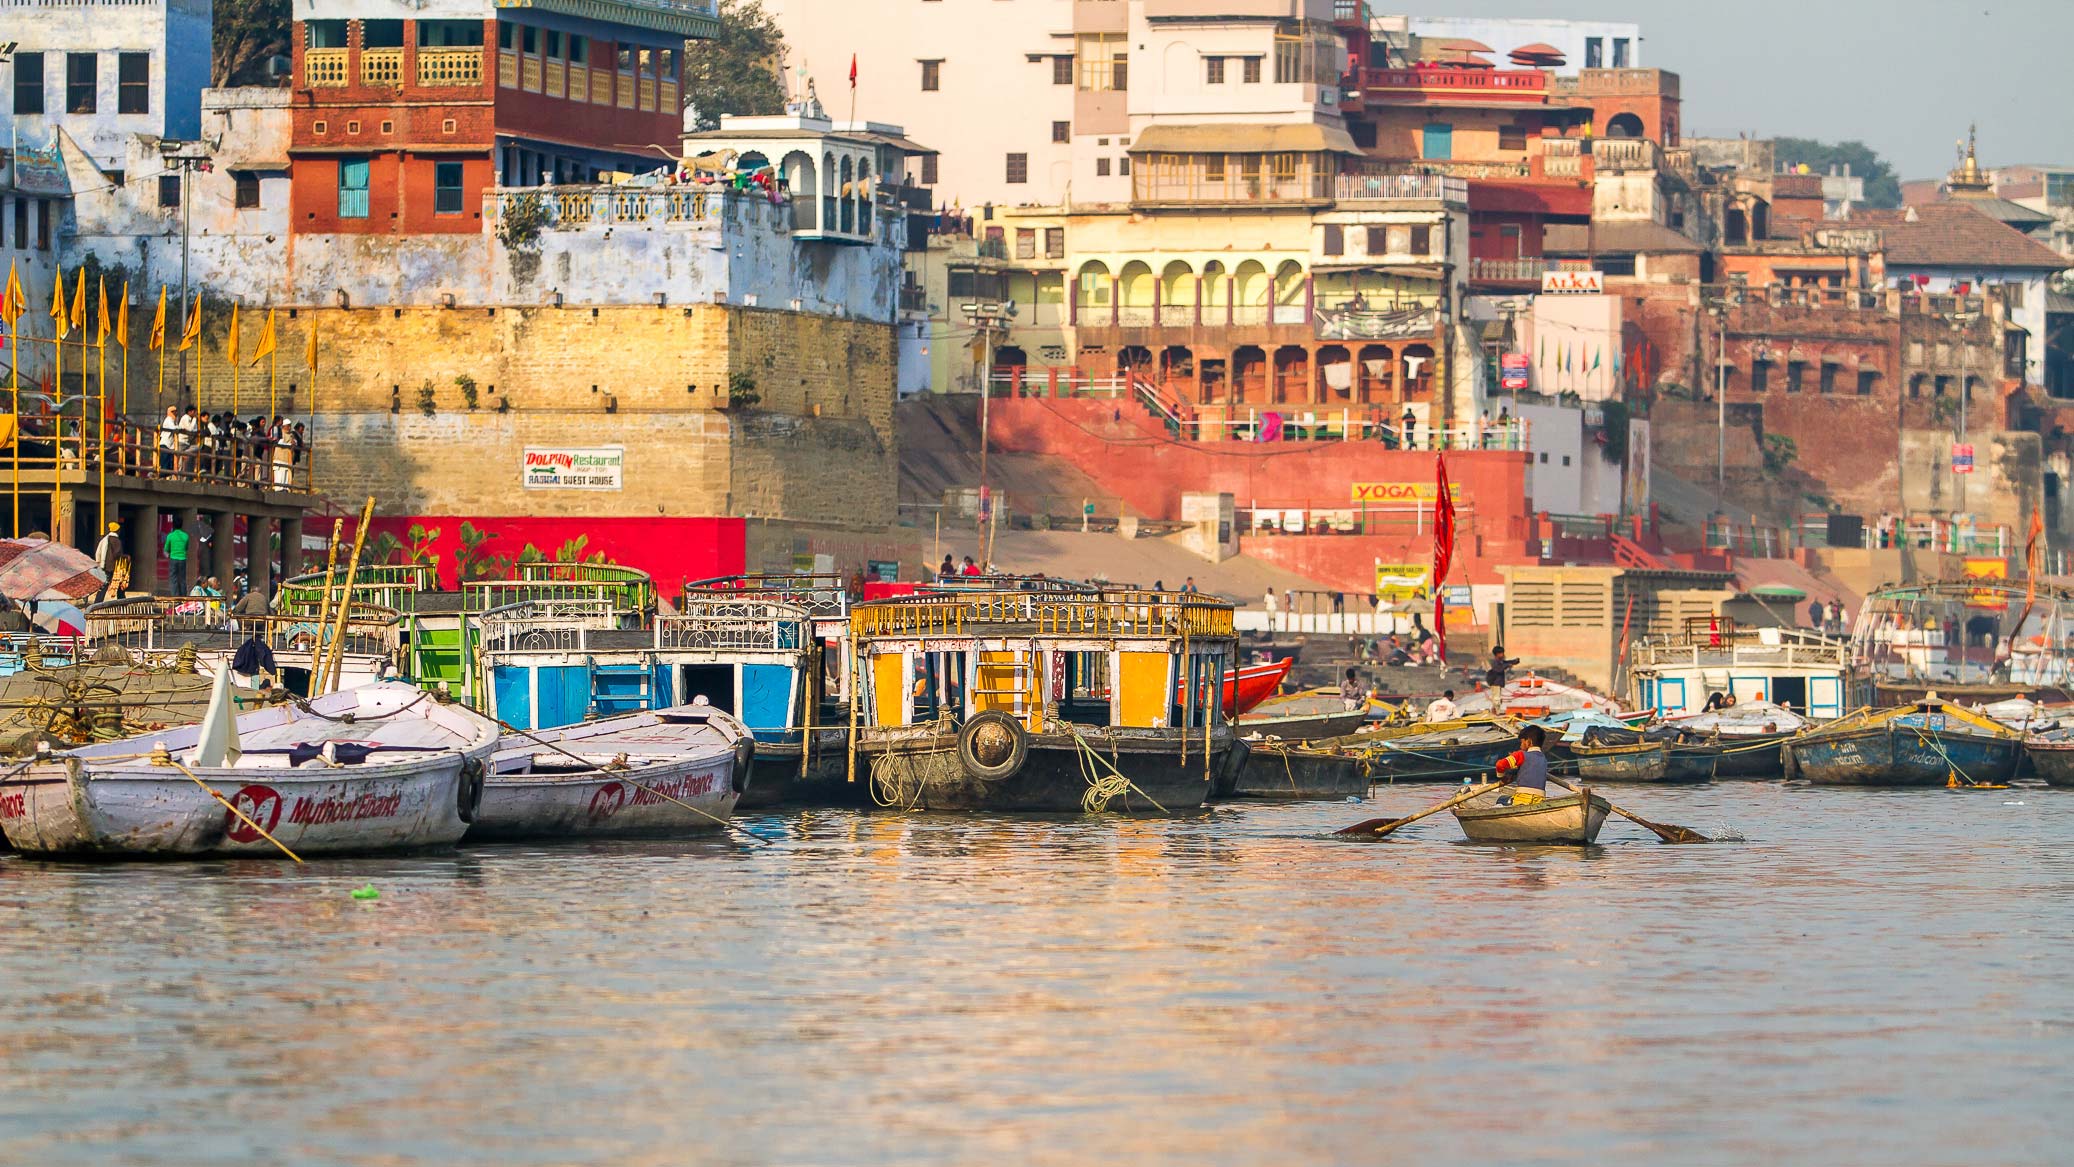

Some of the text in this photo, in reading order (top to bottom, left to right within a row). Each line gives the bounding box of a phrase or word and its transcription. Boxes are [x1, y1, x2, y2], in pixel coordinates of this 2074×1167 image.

[525, 453, 620, 469] DOLPHIN Restaurant
[563, 476, 586, 485] GUEST
[588, 476, 613, 486] HOUSE
[1357, 485, 1416, 498] YOGA
[681, 772, 713, 799] Finance
[288, 796, 357, 825] Muthoot
